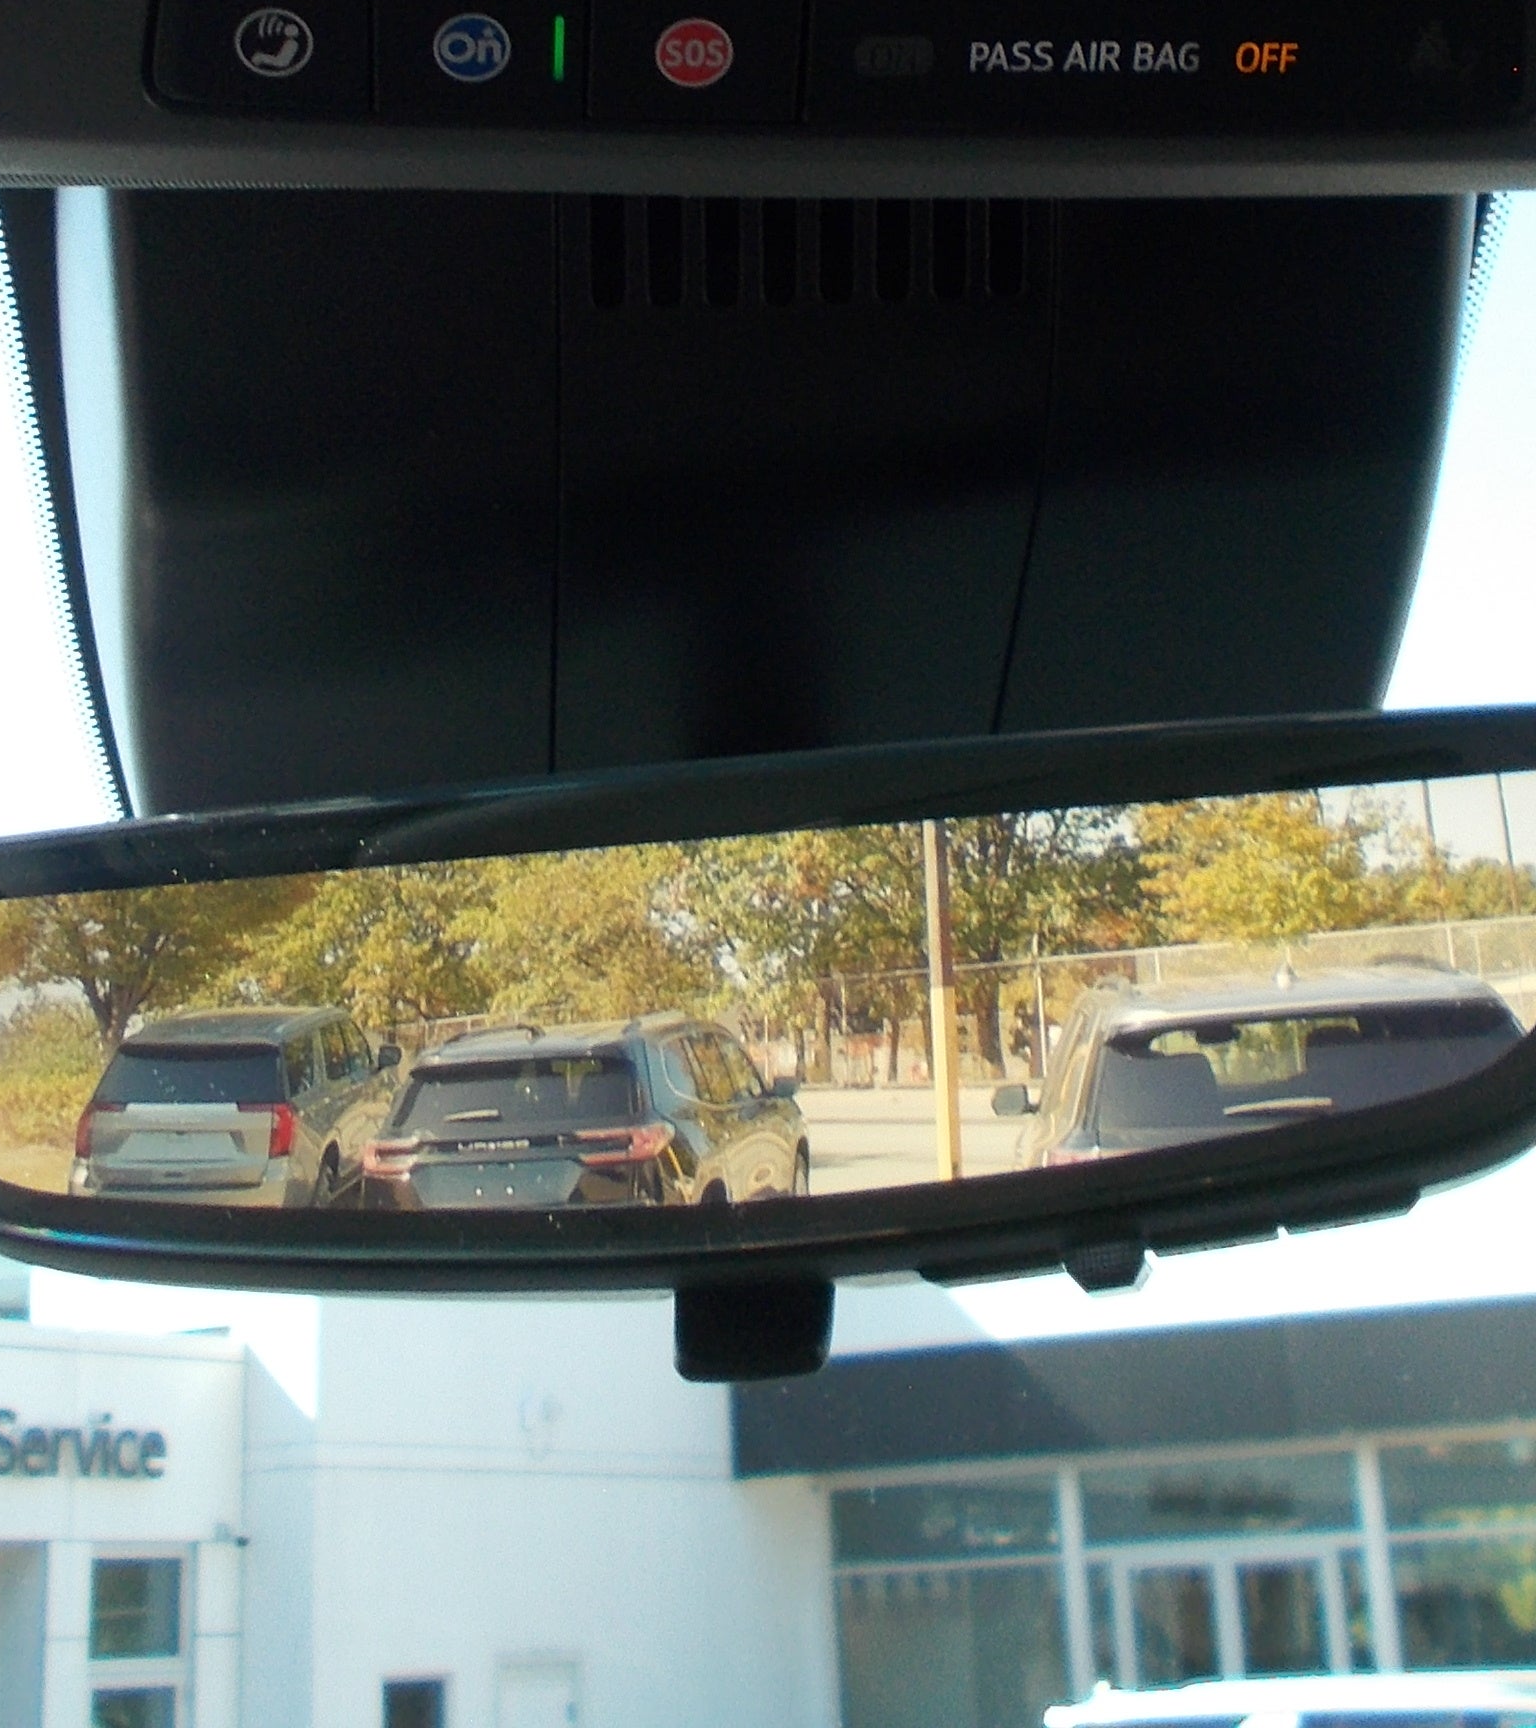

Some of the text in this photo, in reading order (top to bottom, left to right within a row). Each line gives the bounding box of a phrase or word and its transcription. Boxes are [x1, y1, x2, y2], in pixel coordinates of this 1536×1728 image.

[662, 37, 728, 70] SOS
[967, 39, 1301, 75] PASS AIR BAG OFF
